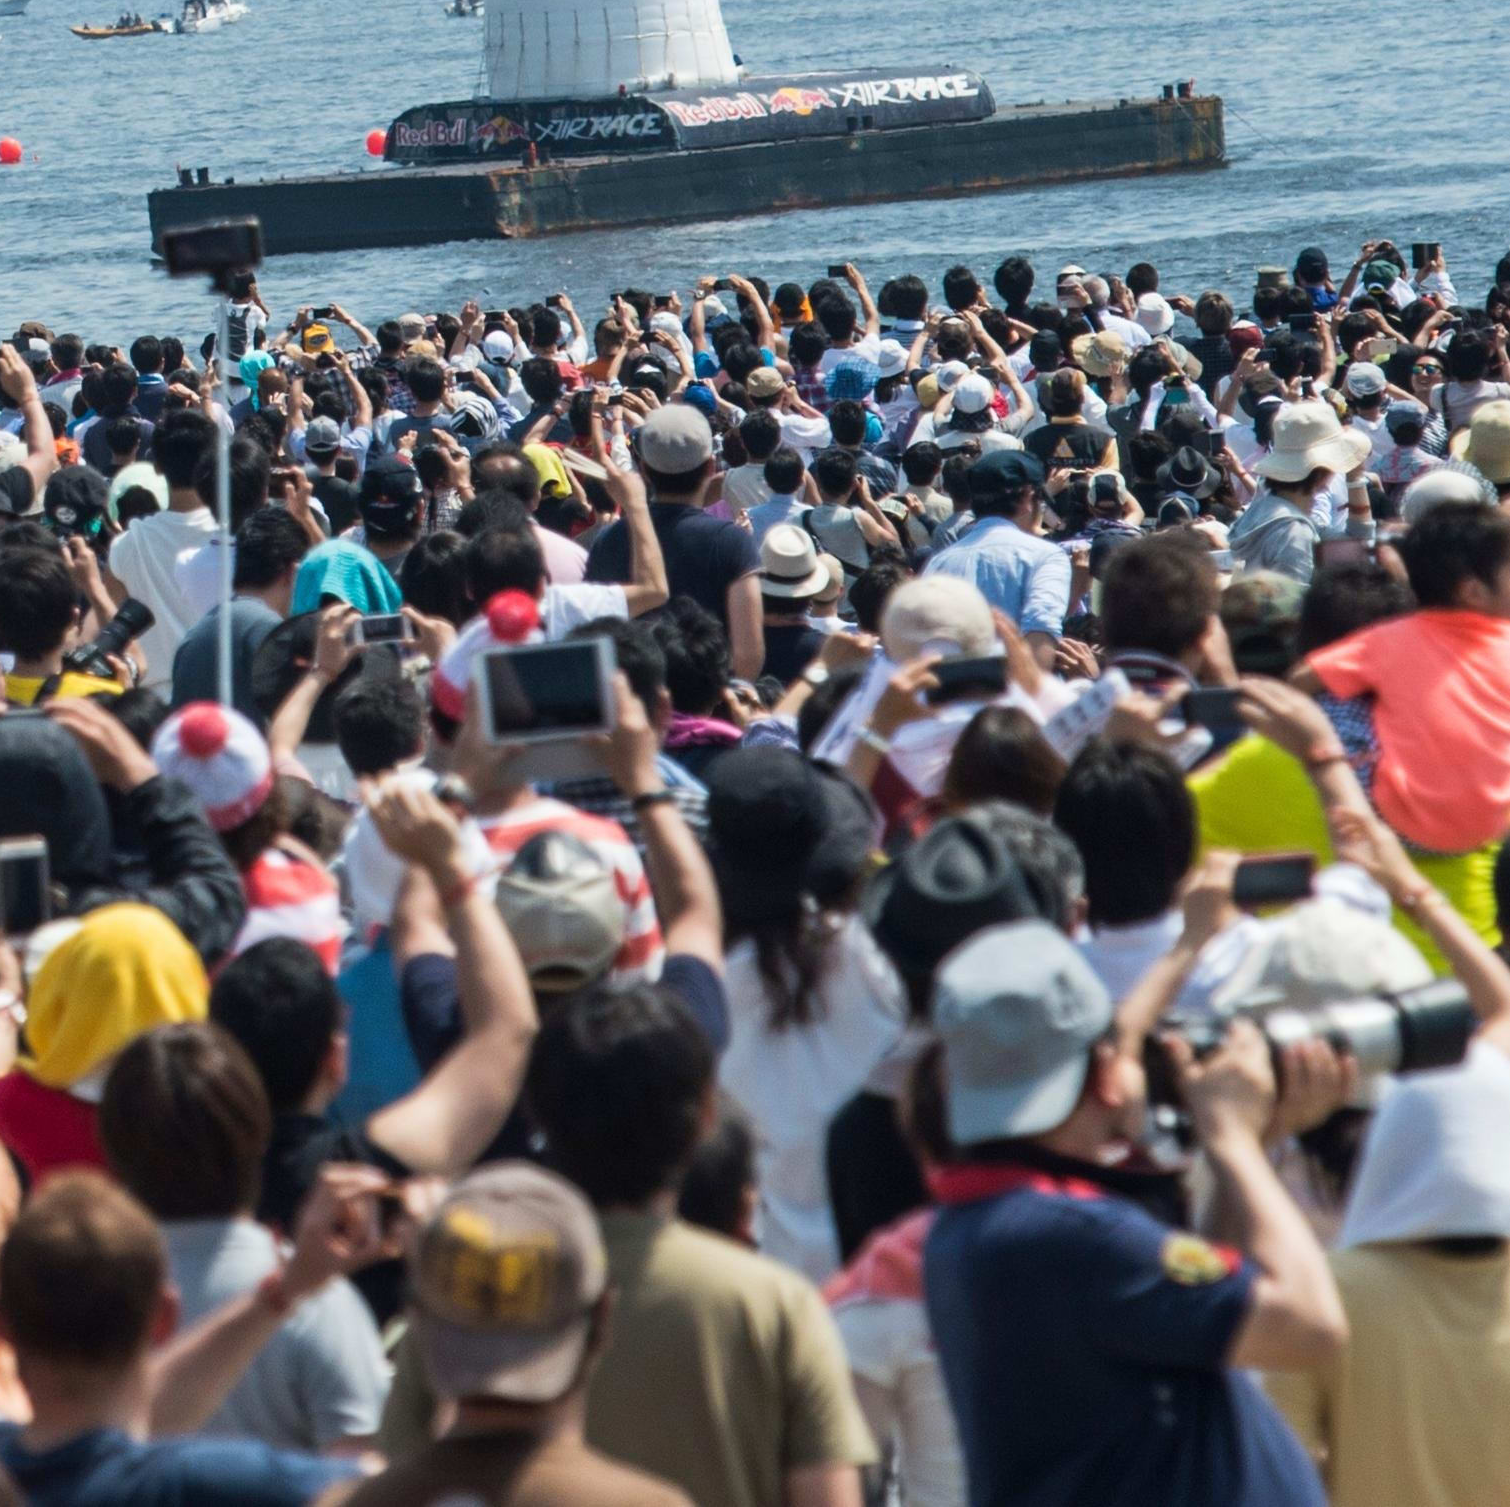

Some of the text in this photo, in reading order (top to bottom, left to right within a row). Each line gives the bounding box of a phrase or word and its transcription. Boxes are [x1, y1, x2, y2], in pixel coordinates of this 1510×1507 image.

[889, 74, 979, 102] RACE
[395, 120, 430, 146] Red
[431, 117, 467, 145] Bull
[589, 112, 662, 138] RACE
